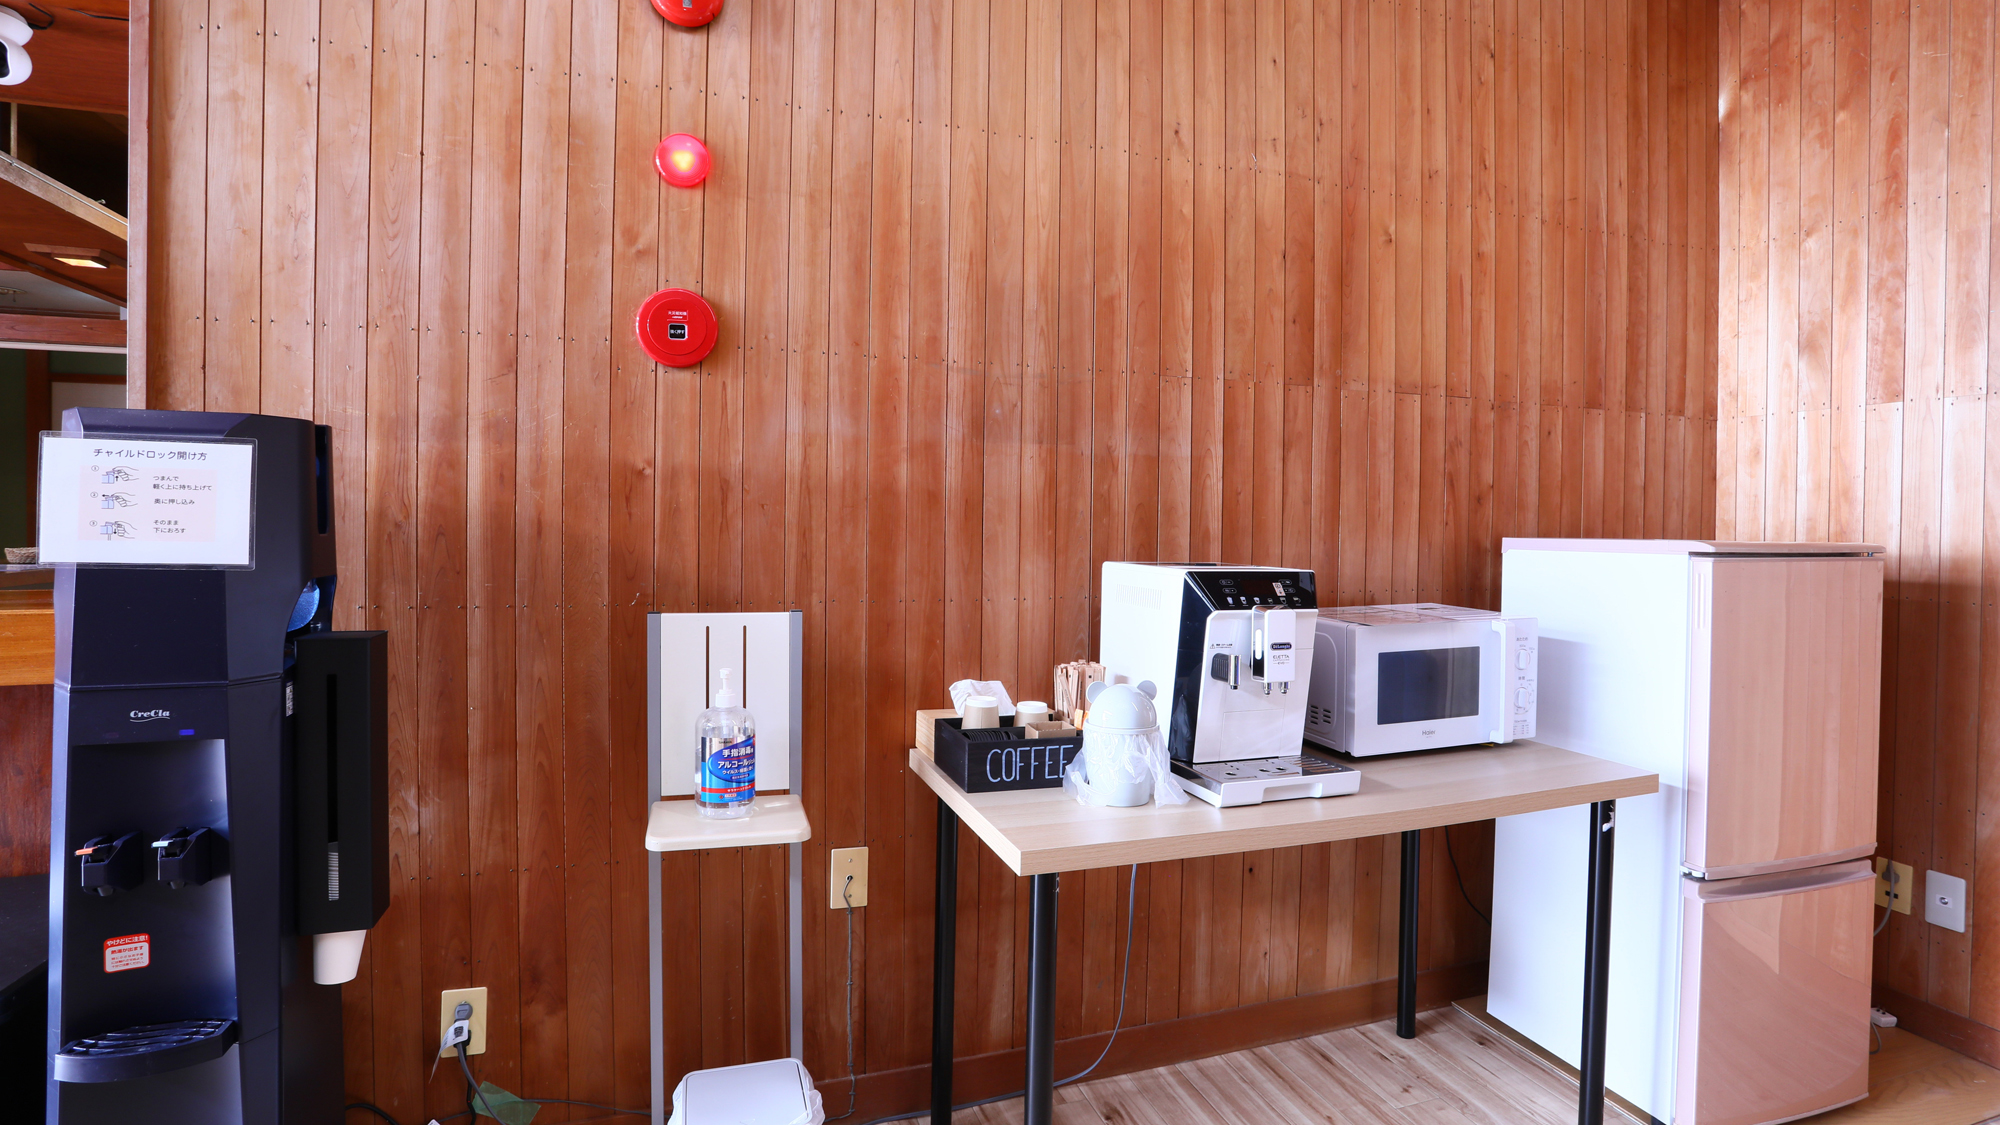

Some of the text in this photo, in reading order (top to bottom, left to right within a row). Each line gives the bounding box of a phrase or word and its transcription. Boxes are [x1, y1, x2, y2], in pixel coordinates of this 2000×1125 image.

[93, 448, 208, 461] チャイルドロック開け方
[152, 483, 213, 491] 軽く上に持ち上げて
[130, 709, 170, 718] CreCla
[986, 744, 1074, 783] COFFEE
